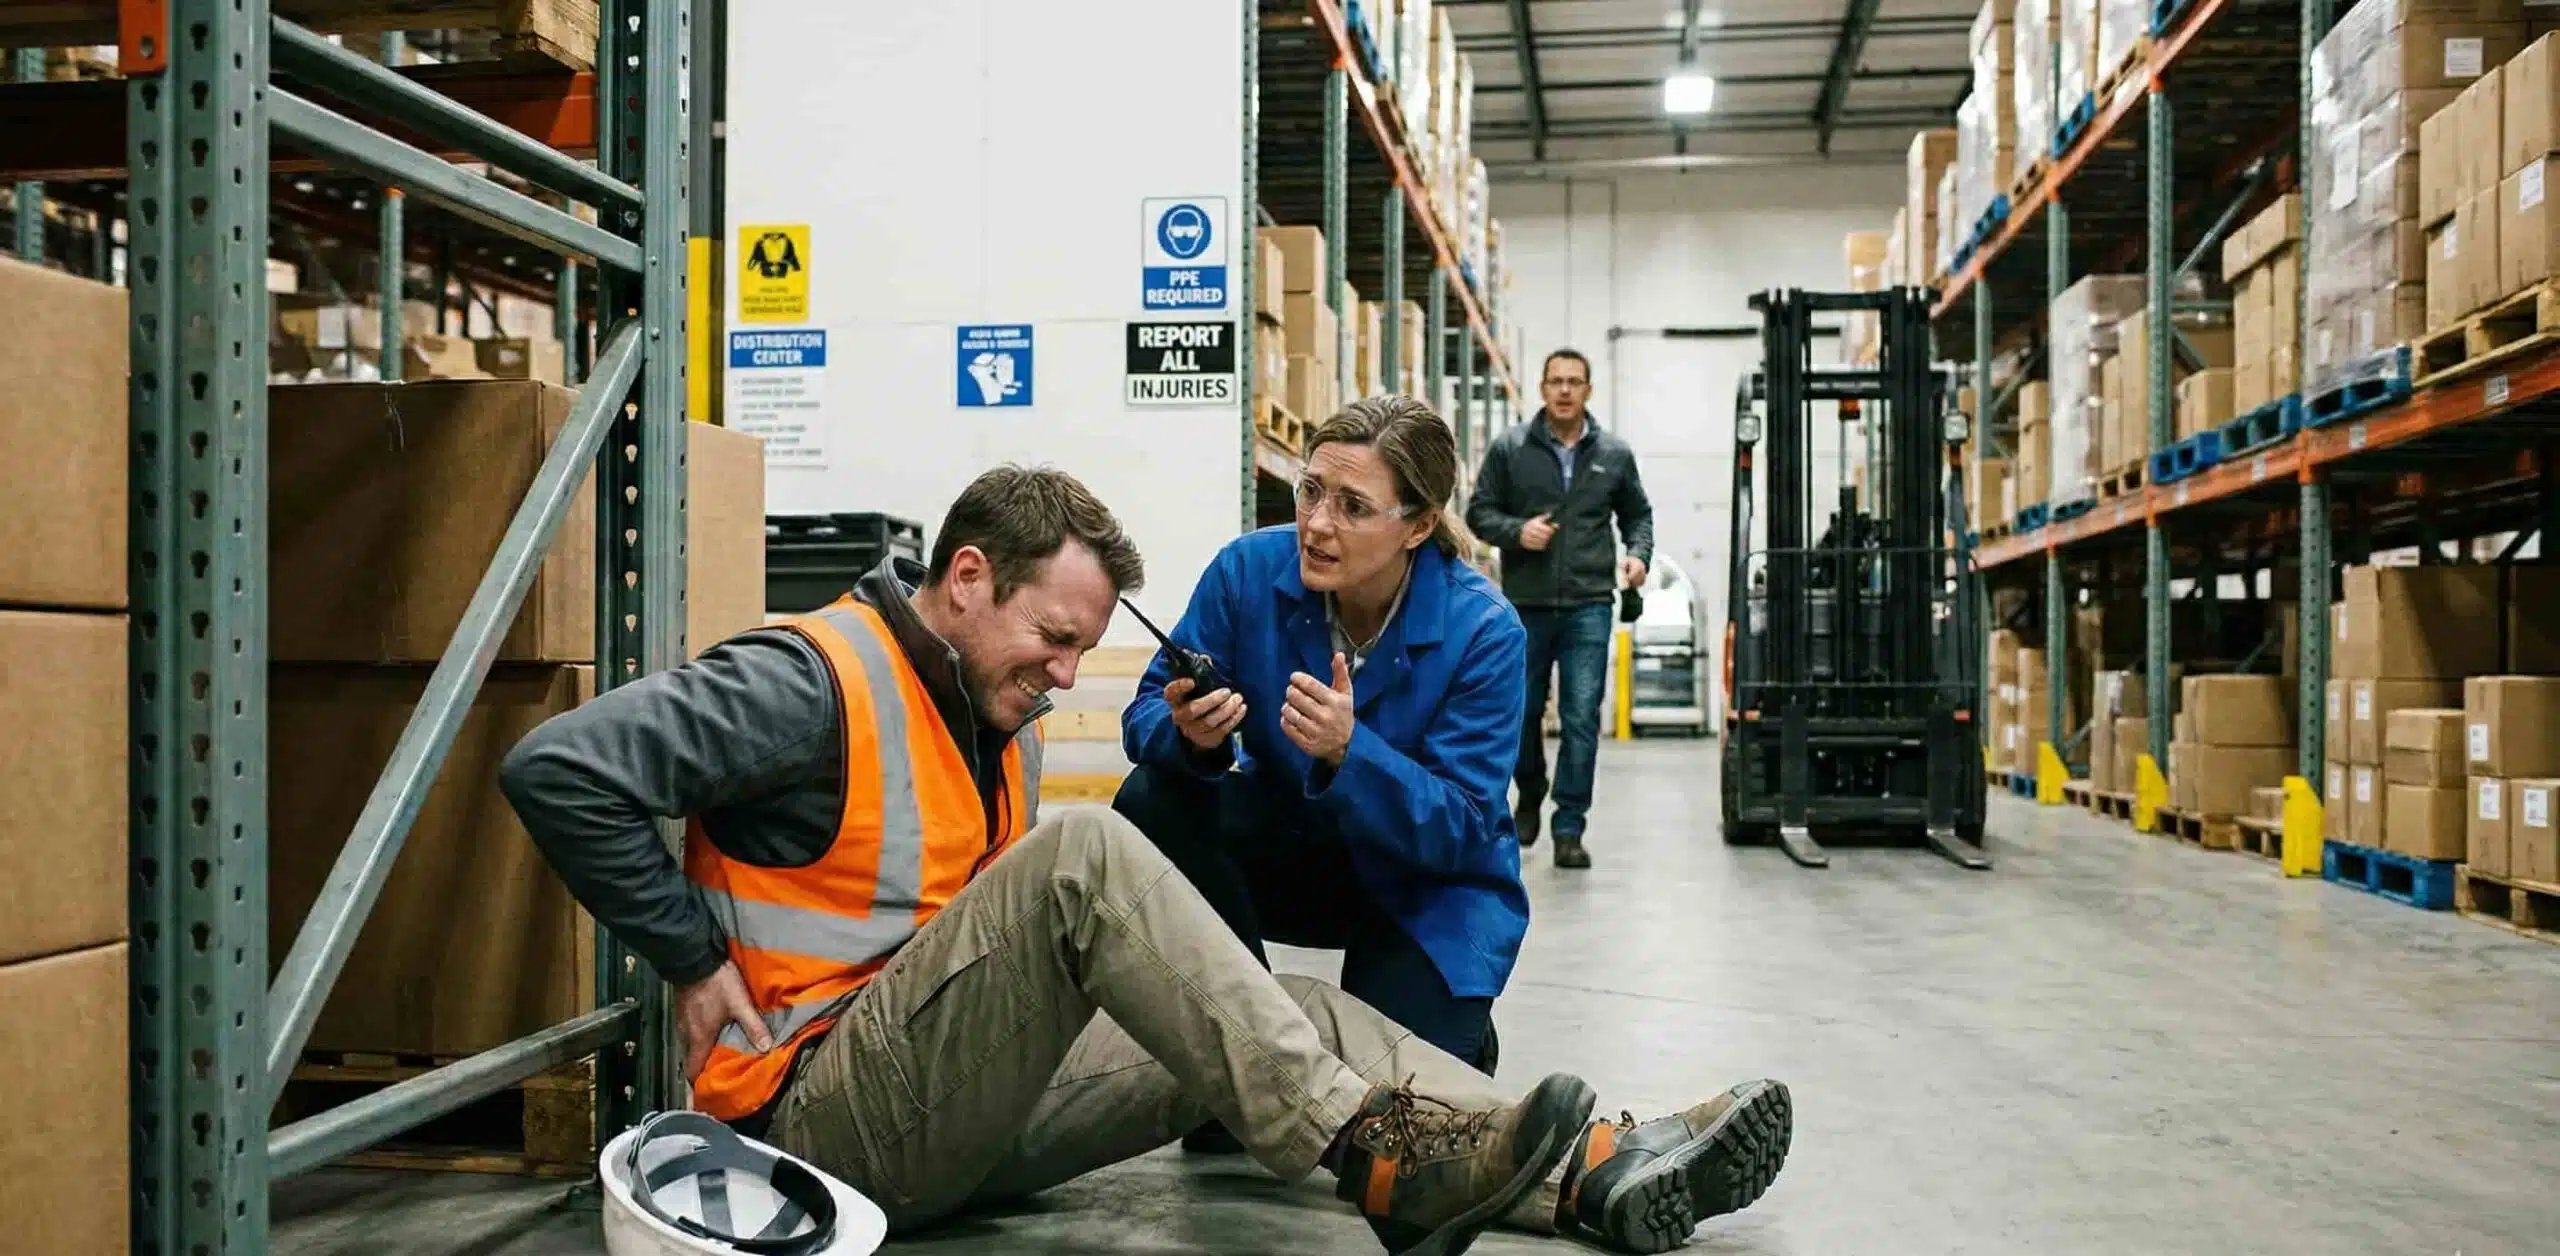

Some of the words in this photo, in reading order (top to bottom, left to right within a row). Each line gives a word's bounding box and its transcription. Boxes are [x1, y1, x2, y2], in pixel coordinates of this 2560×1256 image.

[1169, 271, 1201, 286] PPE
[1146, 288, 1223, 306] REQUIRED
[733, 333, 823, 349] DISTRIBUTION
[1138, 326, 1223, 348] REPORT
[752, 349, 803, 364] CENTER
[1160, 350, 1200, 372] ALL
[1133, 379, 1228, 398] INJURIES
